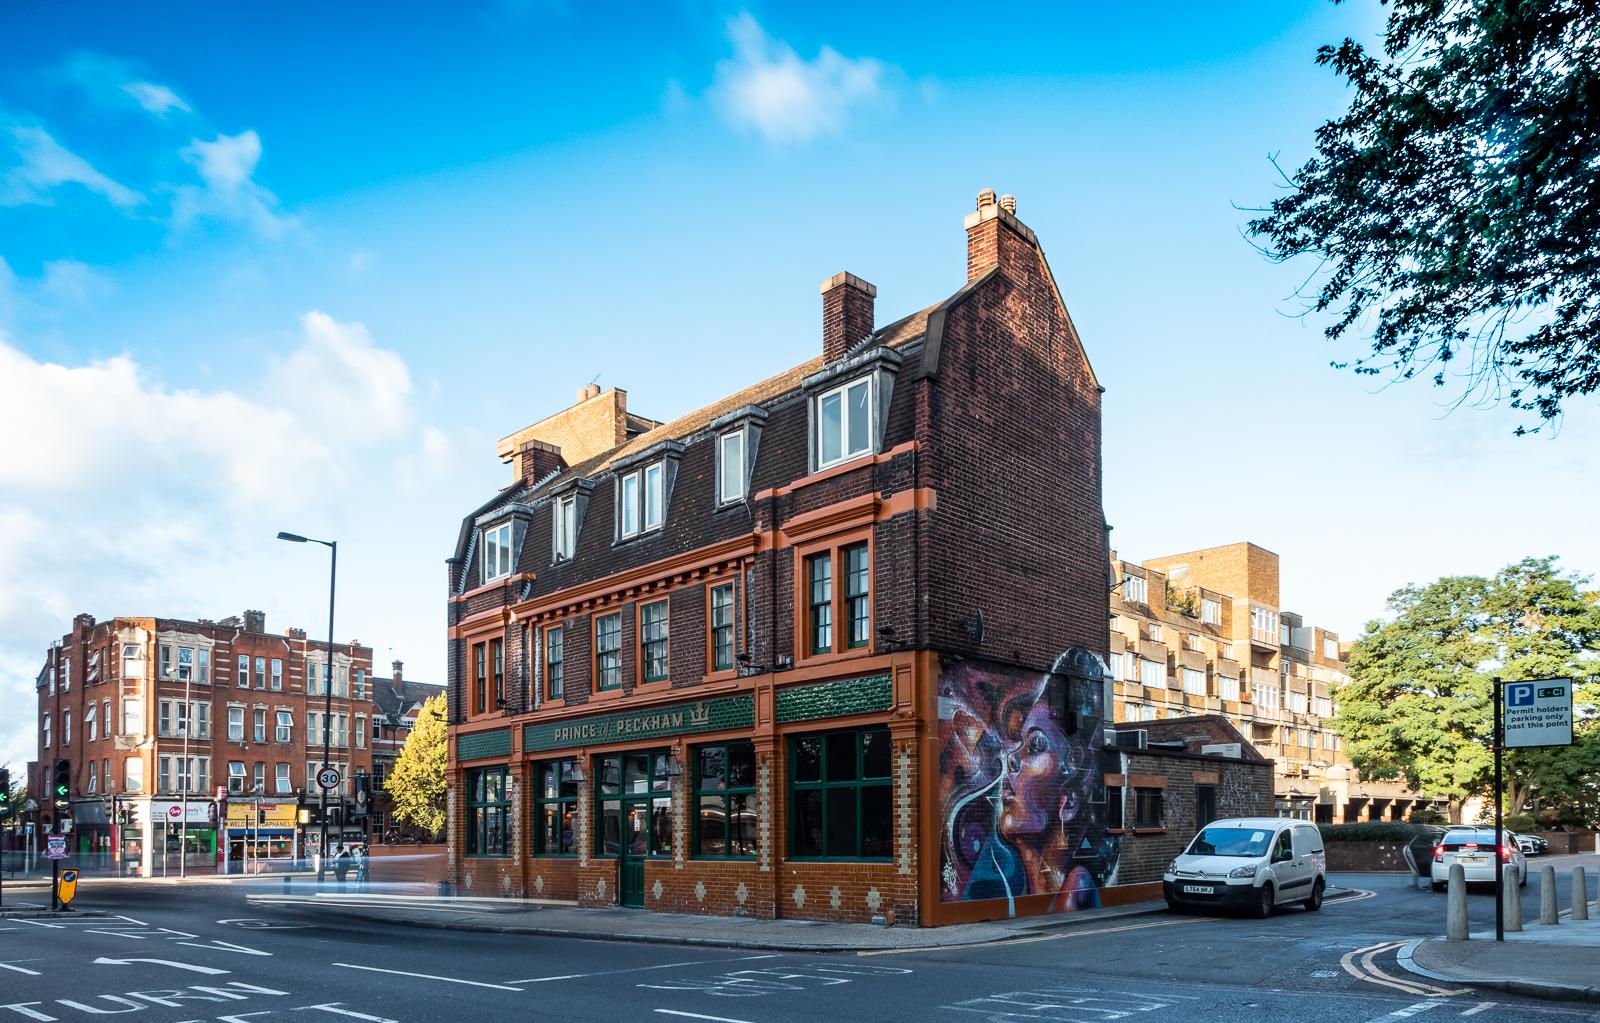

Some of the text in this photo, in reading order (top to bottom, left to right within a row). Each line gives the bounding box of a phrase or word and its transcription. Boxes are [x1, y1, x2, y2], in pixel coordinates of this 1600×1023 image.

[1515, 687, 1530, 705] P
[1539, 689, 1545, 697] E
[1511, 713, 1563, 723] parking only
[1546, 720, 1568, 728] point
[554, 712, 683, 742] PRINCE of PECKHAM
[321, 774, 338, 783] 30
[636, 963, 913, 997] CLEAR
[0, 981, 291, 1021] TURN
